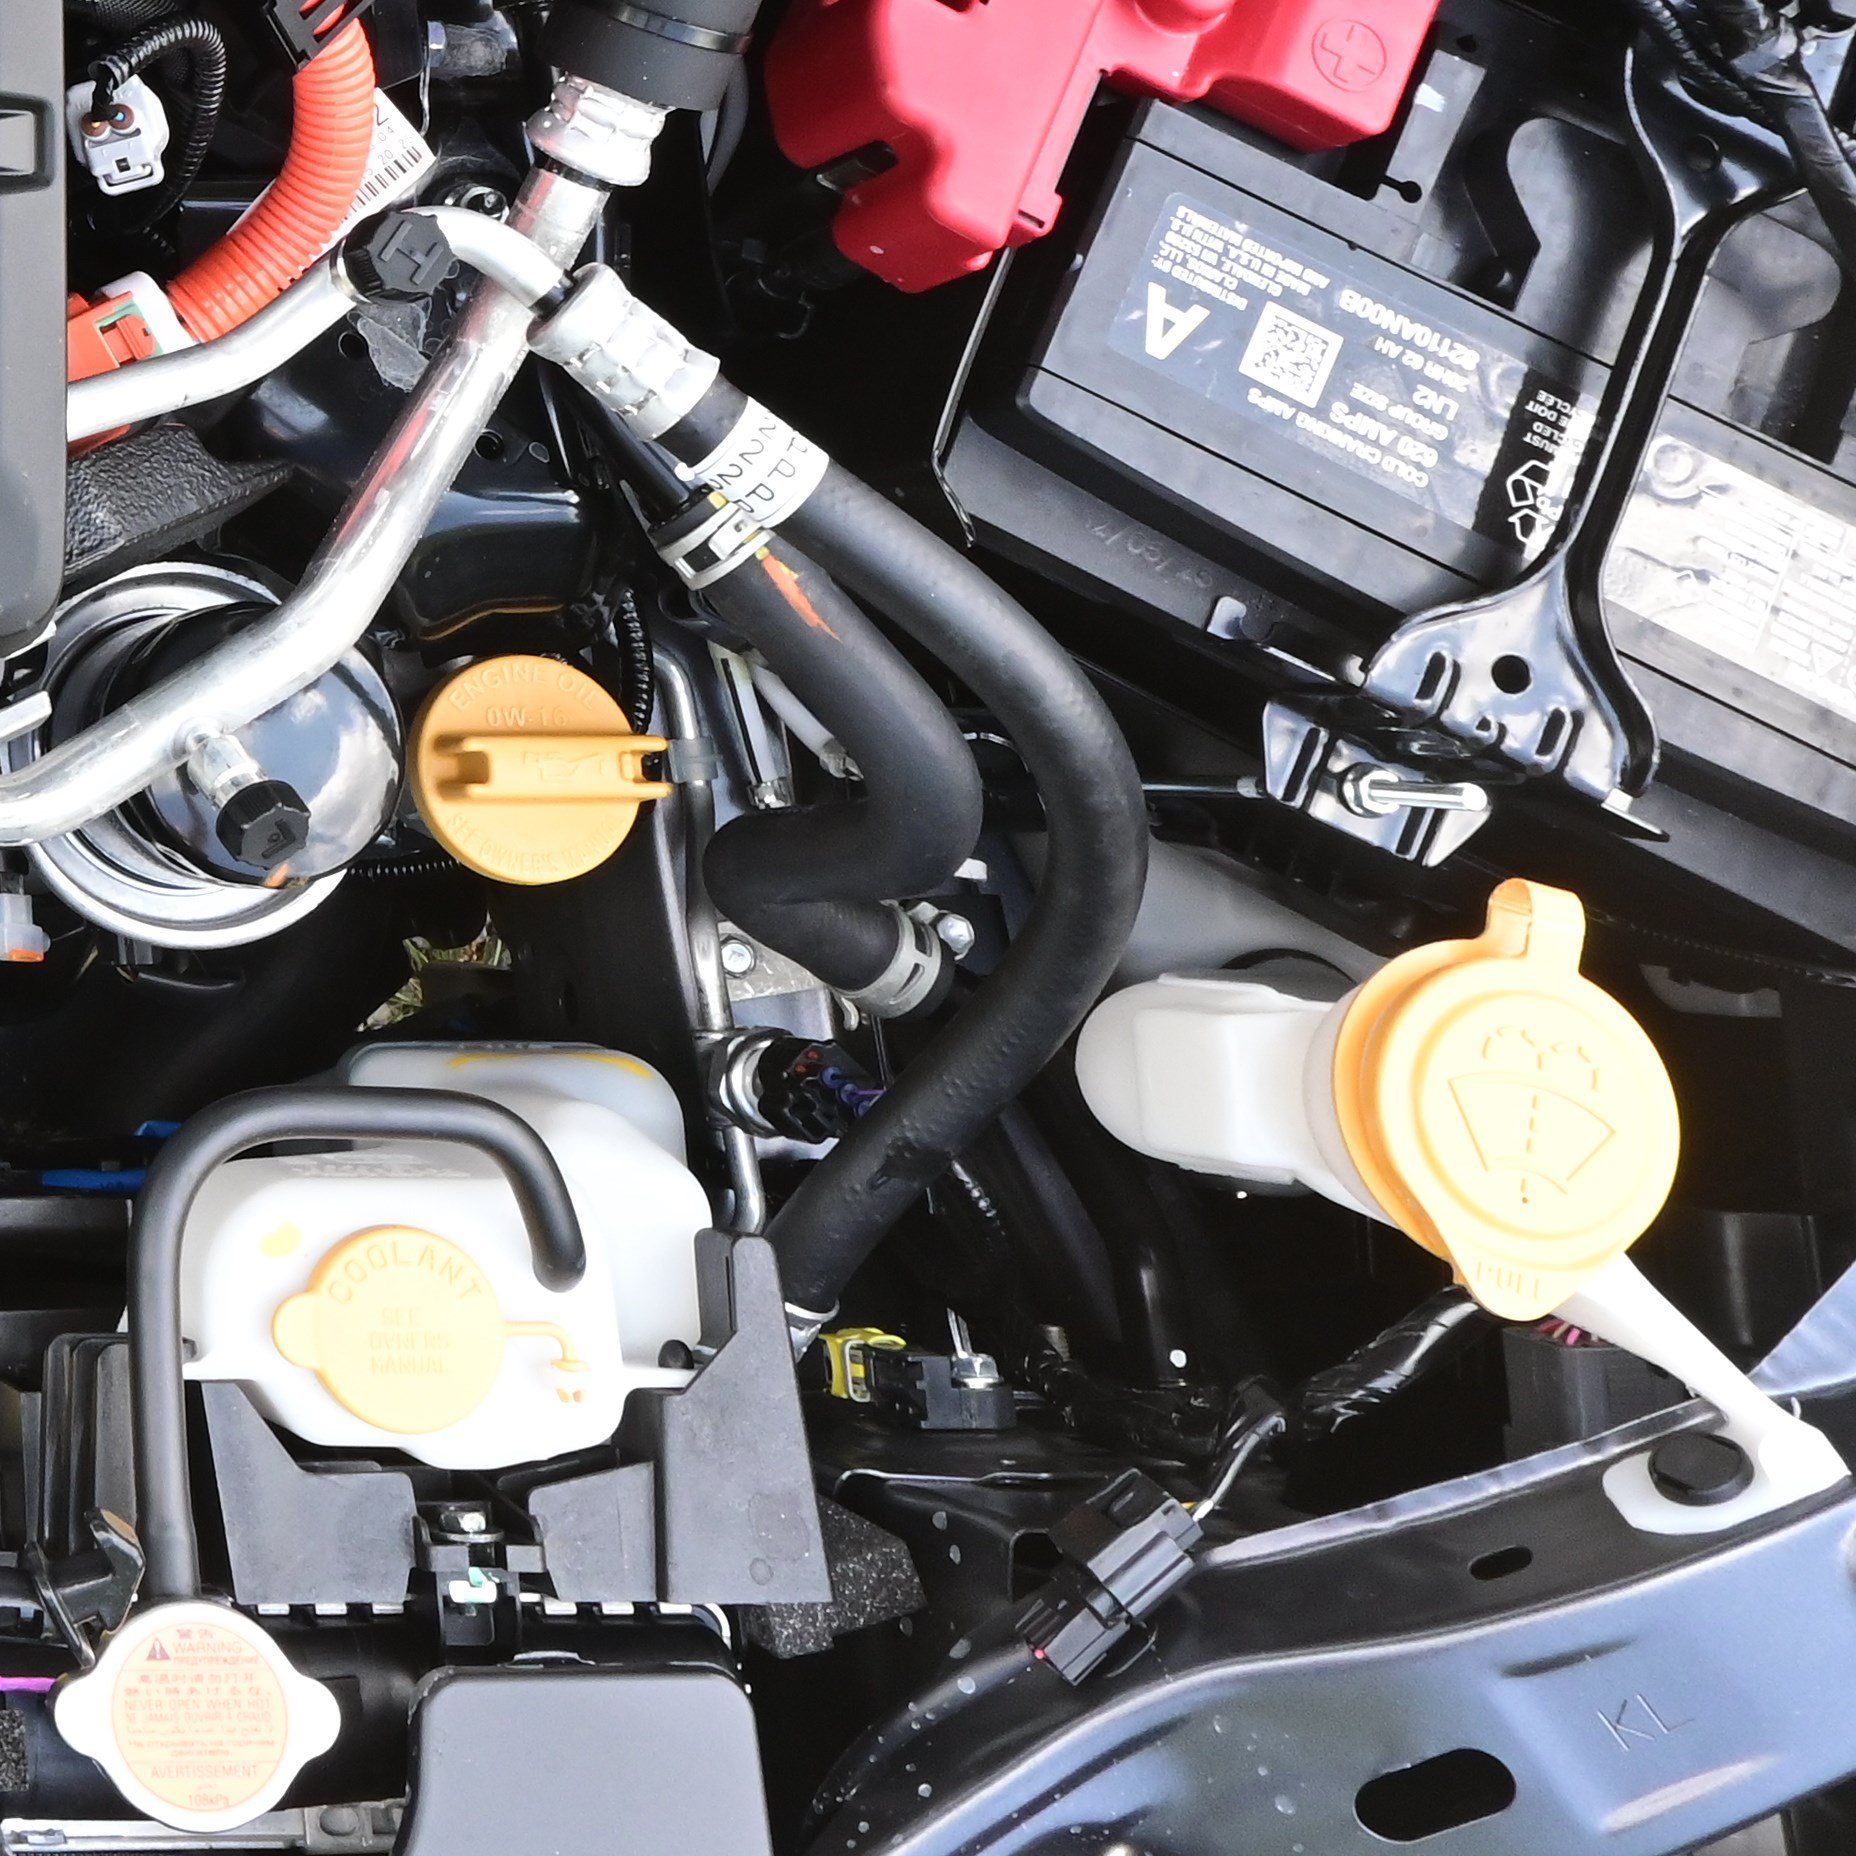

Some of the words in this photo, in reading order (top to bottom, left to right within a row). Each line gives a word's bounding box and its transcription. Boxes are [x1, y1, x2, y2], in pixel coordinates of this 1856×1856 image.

[1174, 203, 1244, 246] MATERIALS
[1190, 227, 1226, 253] WITH
[378, 219, 444, 285] H
[1239, 235, 1305, 276] IMPORTED
[1169, 263, 1249, 310] DISTRIBUTED
[1272, 267, 1312, 296] MADE
[1302, 266, 1331, 289] AND
[1143, 281, 1211, 362] A
[1335, 286, 1483, 372] 82110AN00B
[1373, 334, 1404, 359] AH
[1244, 385, 1297, 422] AMPS
[1348, 380, 1390, 411] SIZE
[1409, 382, 1461, 420] LN2
[1524, 398, 1558, 422] DOIT
[1292, 409, 1385, 465] CRANKING
[1326, 399, 1399, 448] AMPS
[1386, 399, 1450, 441] GROUP
[1394, 433, 1441, 469] 620
[1381, 453, 1431, 489] COLD
[447, 661, 544, 711] ENGINE
[557, 672, 602, 711] OIL
[485, 705, 569, 727] 0W-16
[328, 1240, 483, 1304] COOLANT
[1476, 1259, 1545, 1300] PULL
[370, 1355, 447, 1375] MANUAL
[173, 1642, 242, 1653] WARNING
[125, 1700, 162, 1710] NEVER
[169, 1700, 200, 1710] OPEN
[207, 1700, 241, 1710] WHEN
[185, 1713, 222, 1722] OUVRIR
[1597, 1693, 1695, 1751] KL
[151, 1765, 258, 1778] AVERTISSEMENT
